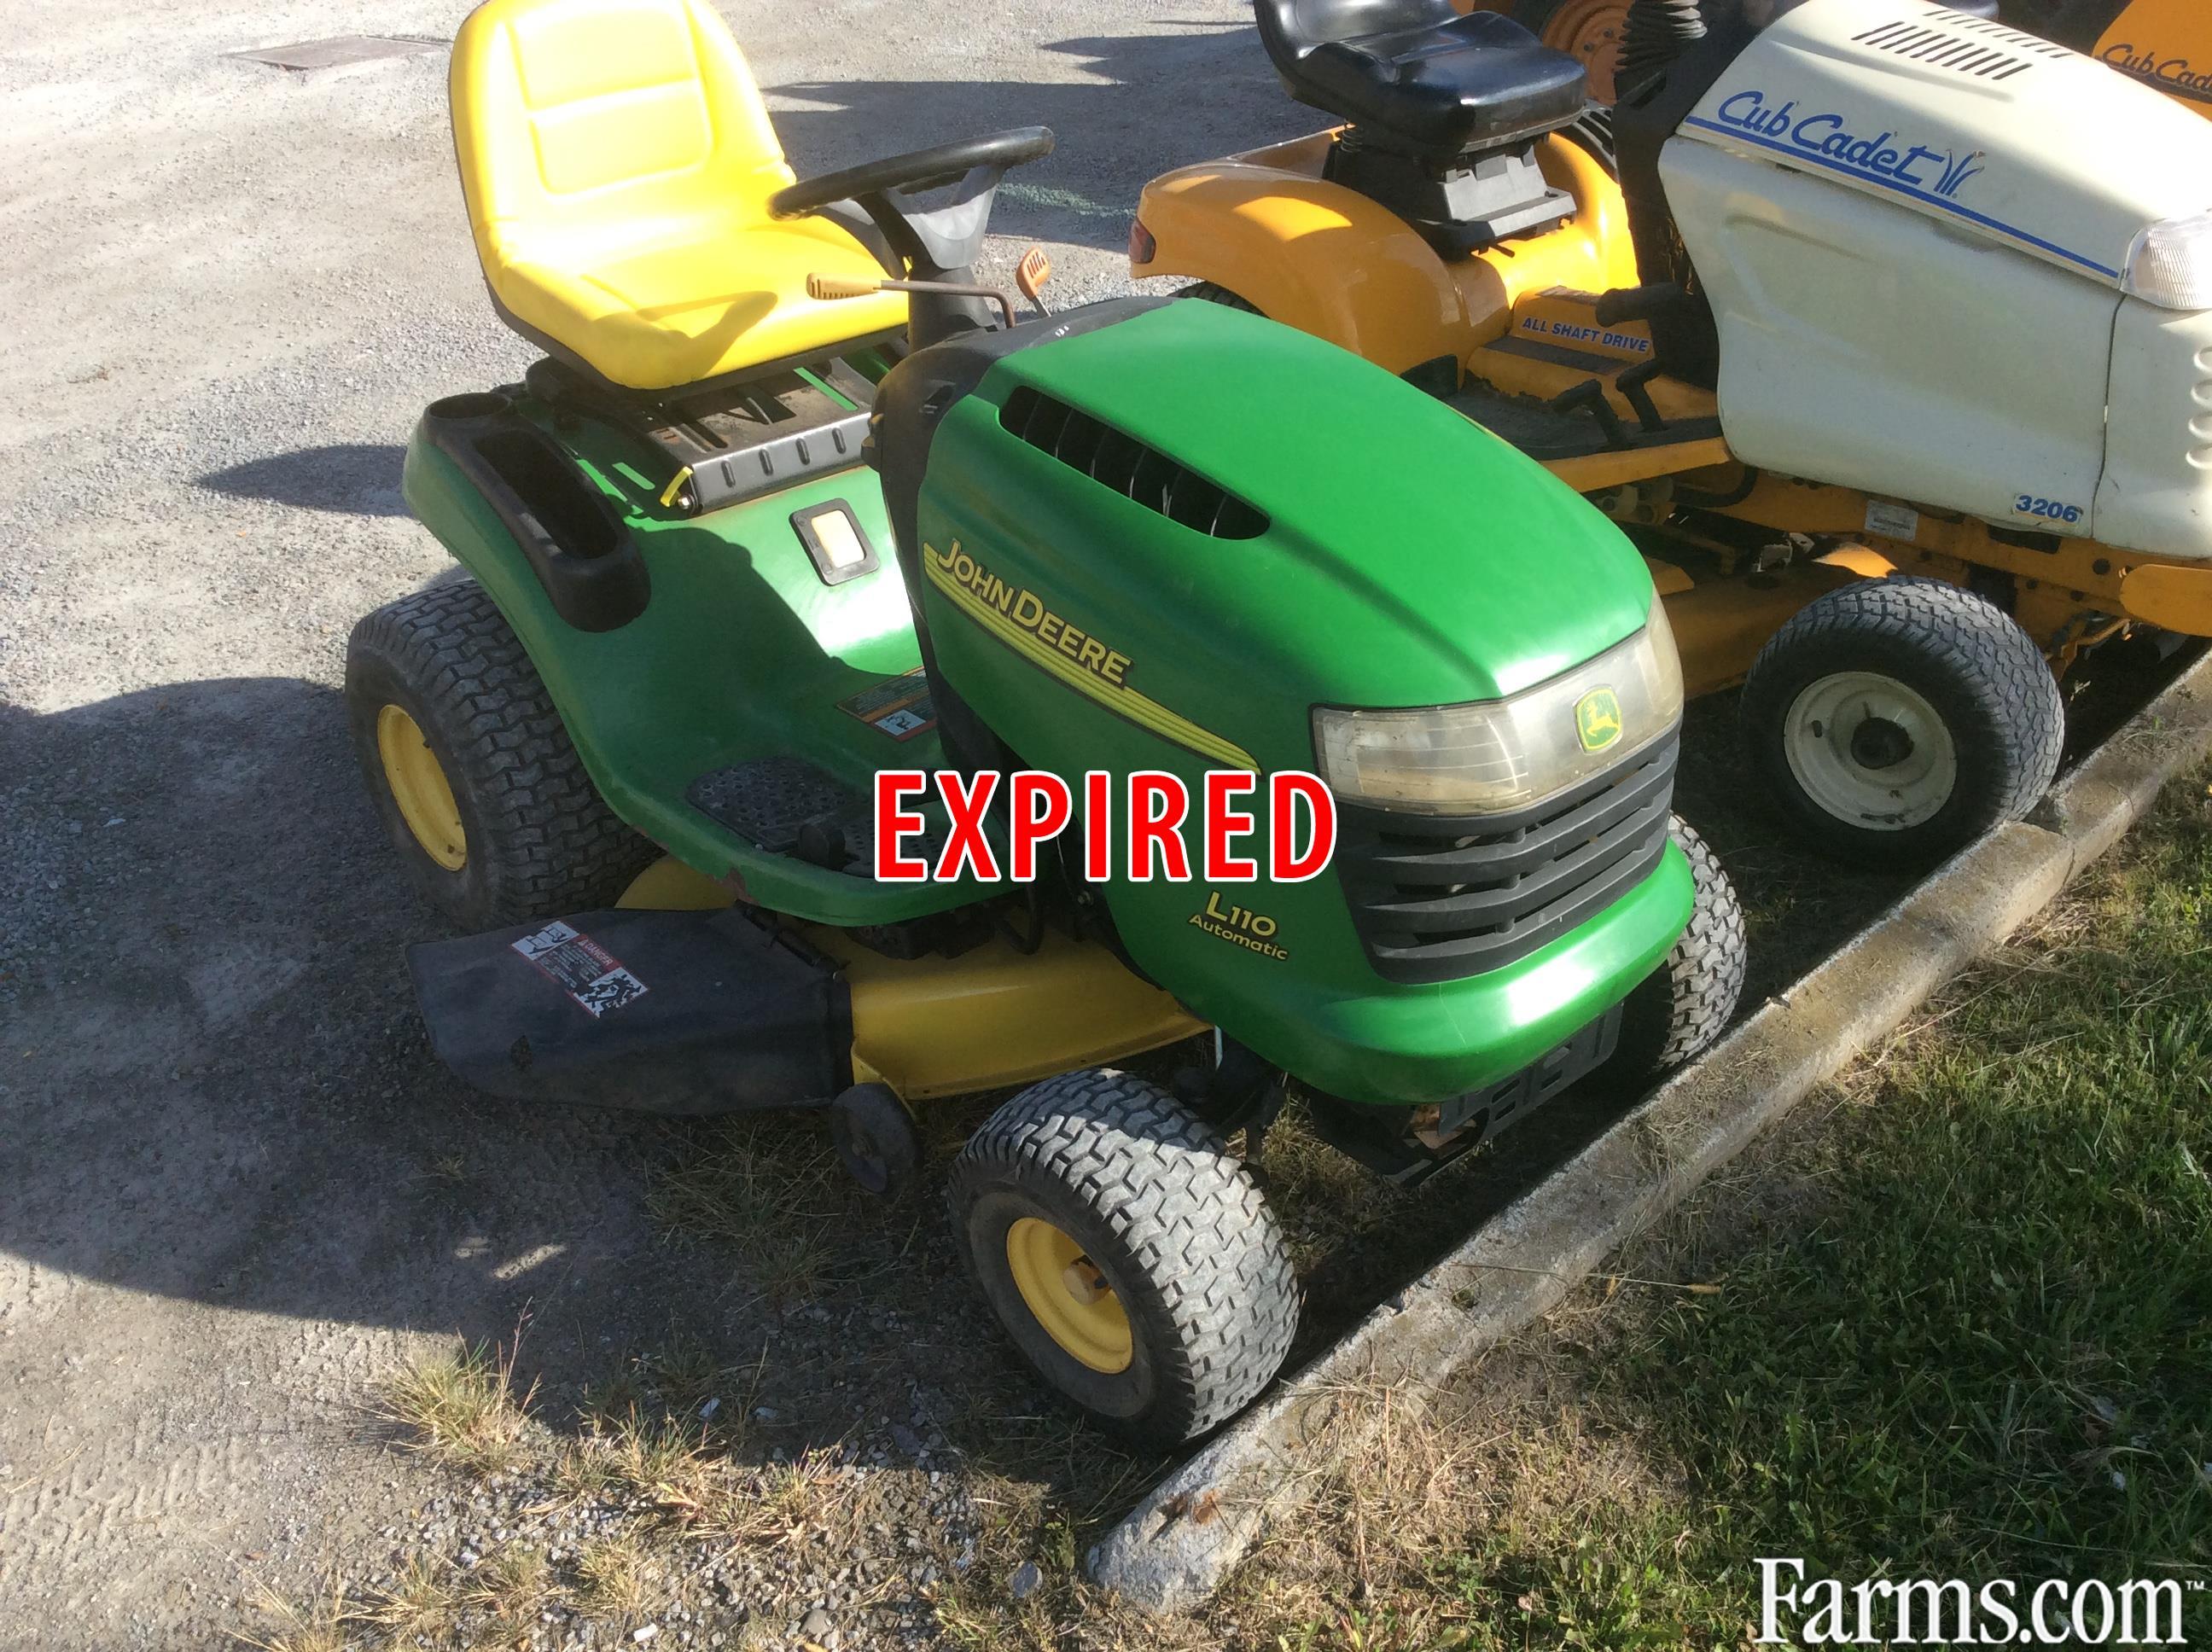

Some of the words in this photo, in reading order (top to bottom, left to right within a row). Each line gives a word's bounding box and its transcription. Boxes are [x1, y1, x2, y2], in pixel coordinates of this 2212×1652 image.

[2102, 44, 2155, 73] Cub
[1718, 90, 1795, 137] Cub
[1791, 113, 1945, 185] Cadet
[1522, 317, 1547, 333] ALL
[1551, 323, 1600, 343] SHAFT
[1601, 332, 1649, 352] DRIVE
[2016, 495, 2079, 522] 3206
[937, 539, 1016, 614] JOHN
[1012, 588, 1132, 685] DEERE
[1205, 890, 1278, 938] L110
[585, 942, 614, 966] DANGER
[1188, 914, 1289, 961] Automatic
